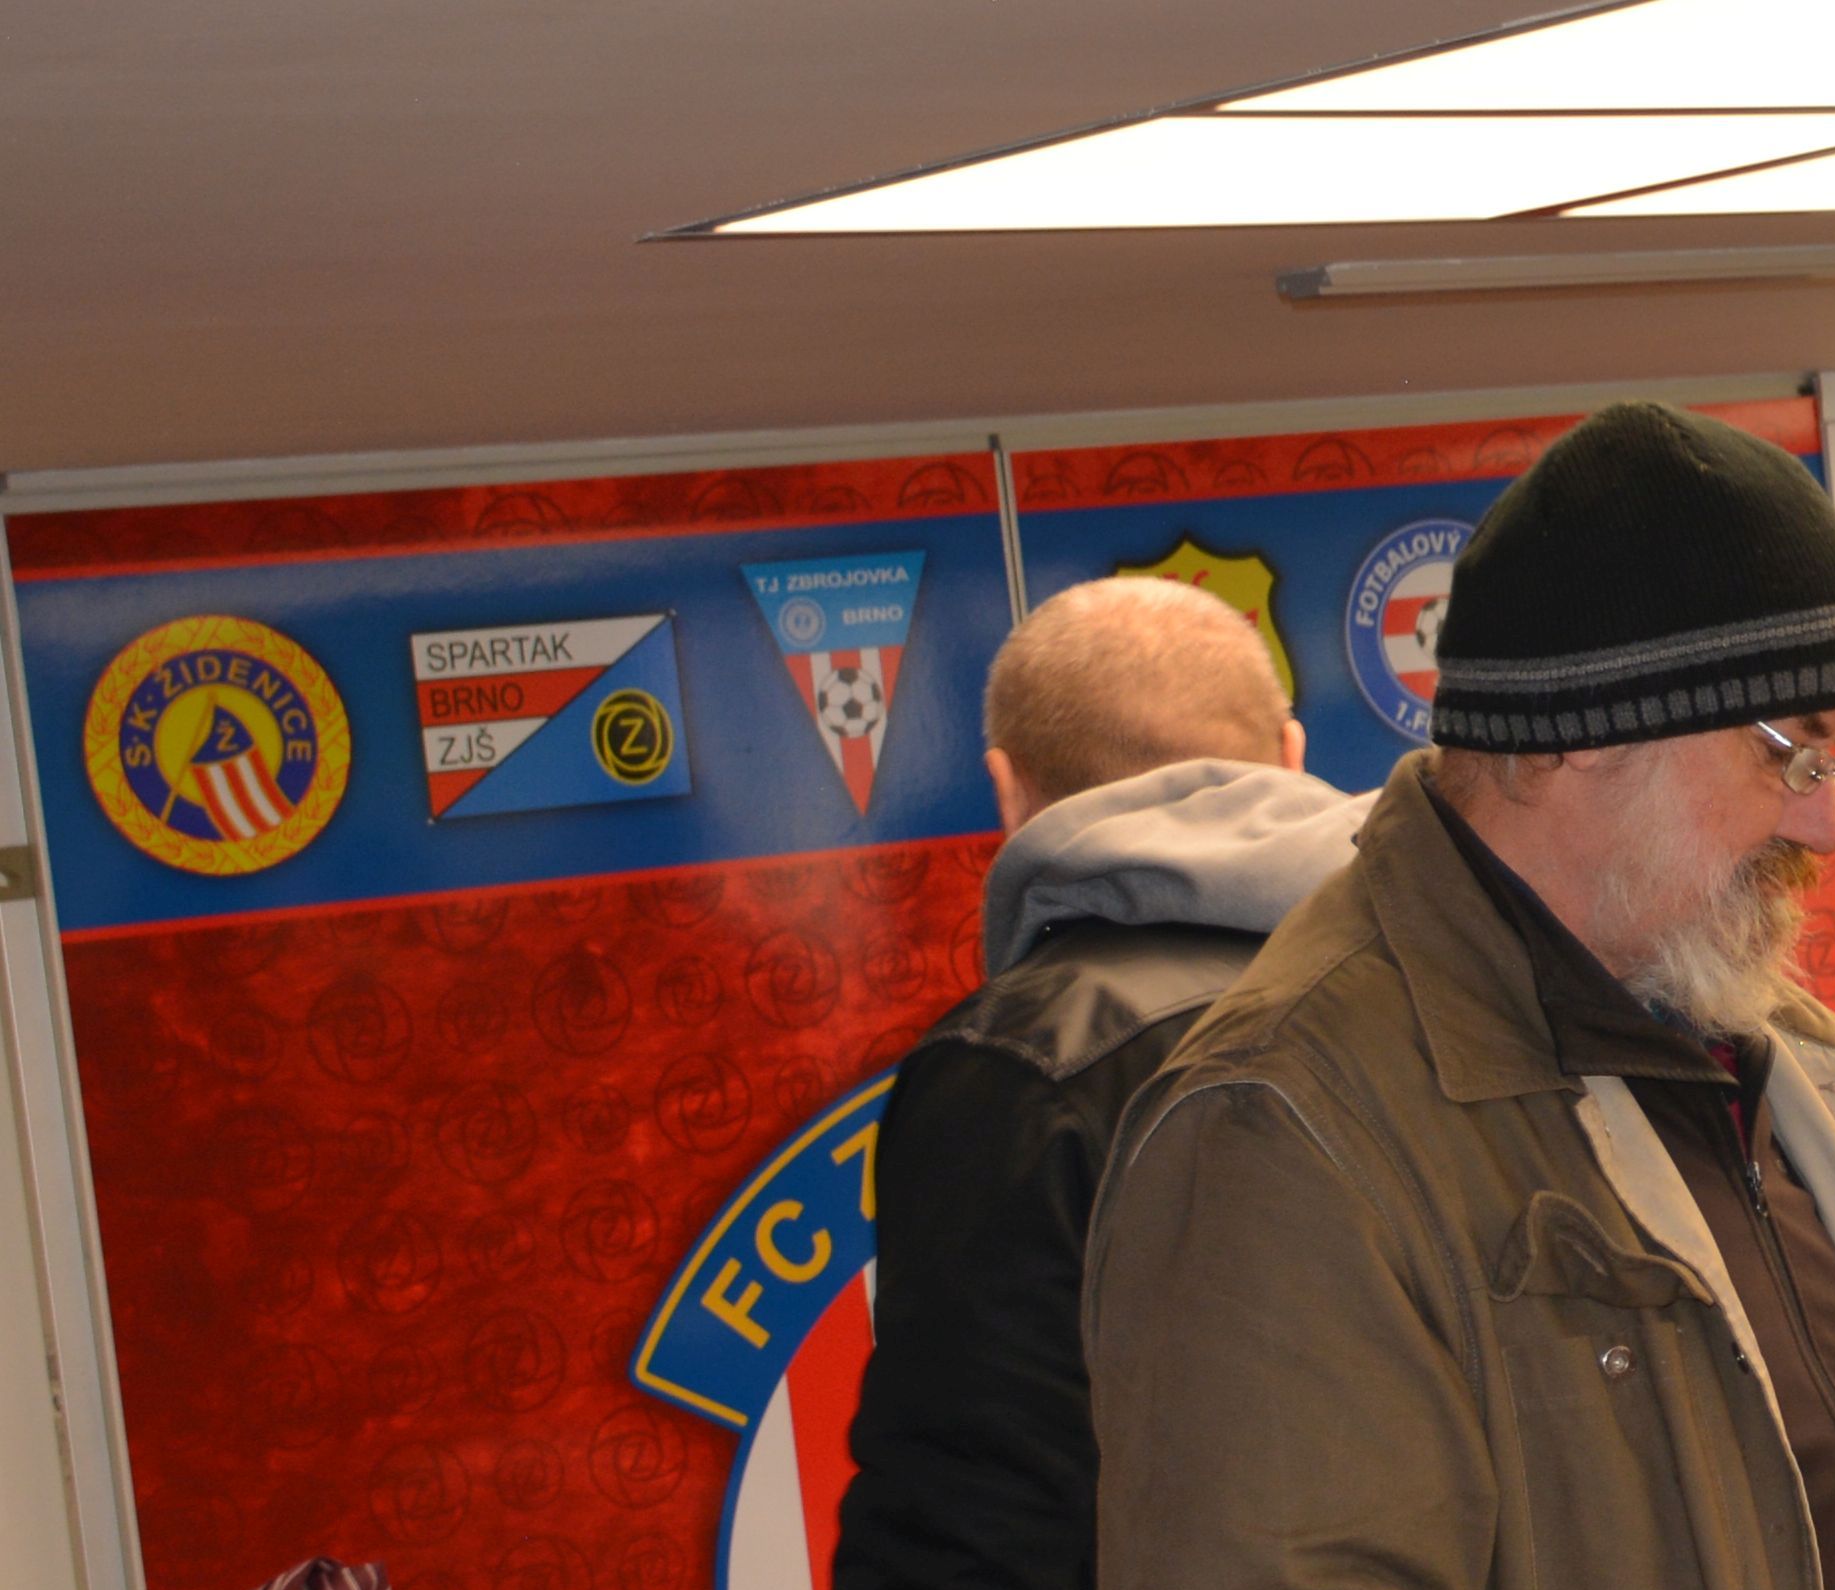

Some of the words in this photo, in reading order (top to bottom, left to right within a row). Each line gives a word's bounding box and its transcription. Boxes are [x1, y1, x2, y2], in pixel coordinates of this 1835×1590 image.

[756, 577, 780, 593] TJ
[787, 565, 909, 592] ZBROJOVKA
[1355, 529, 1461, 627] FOTBALOVÝ
[843, 604, 903, 625] BRNO
[426, 632, 573, 672] SPARTAK
[154, 655, 312, 761] ŽIDENICE
[430, 682, 525, 719] BRNO
[438, 727, 497, 766] ZJŠ
[701, 1199, 832, 1349] FC
